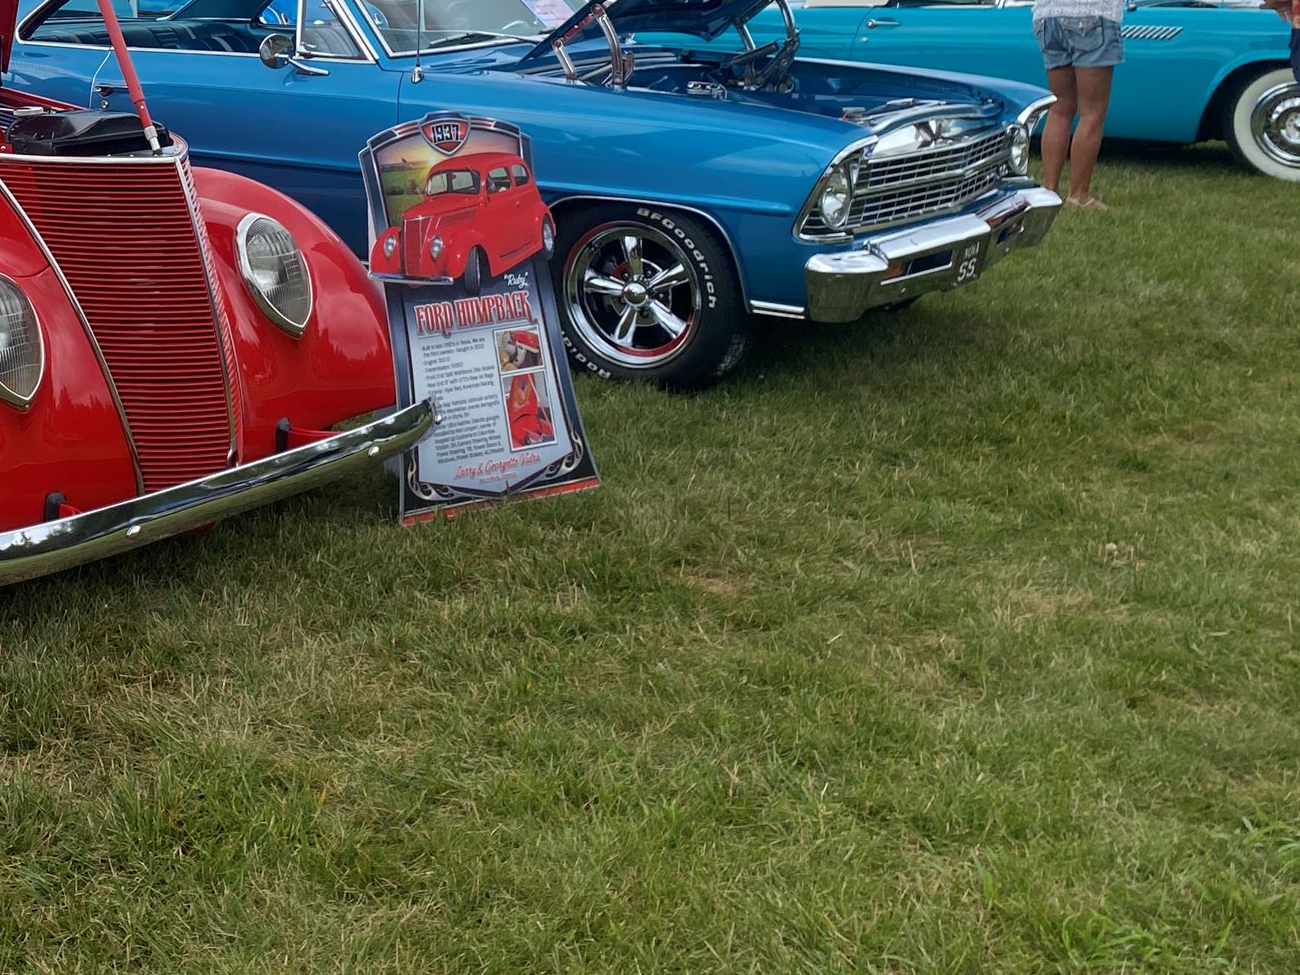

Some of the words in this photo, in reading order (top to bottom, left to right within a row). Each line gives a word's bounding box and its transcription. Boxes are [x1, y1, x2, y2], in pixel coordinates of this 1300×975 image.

[431, 124, 460, 143] 1937
[636, 206, 717, 309] BFGoodrich
[957, 257, 977, 281] SS
[414, 301, 454, 338] FORD
[454, 290, 538, 329] HUMPBACK
[560, 330, 612, 379] Radia
